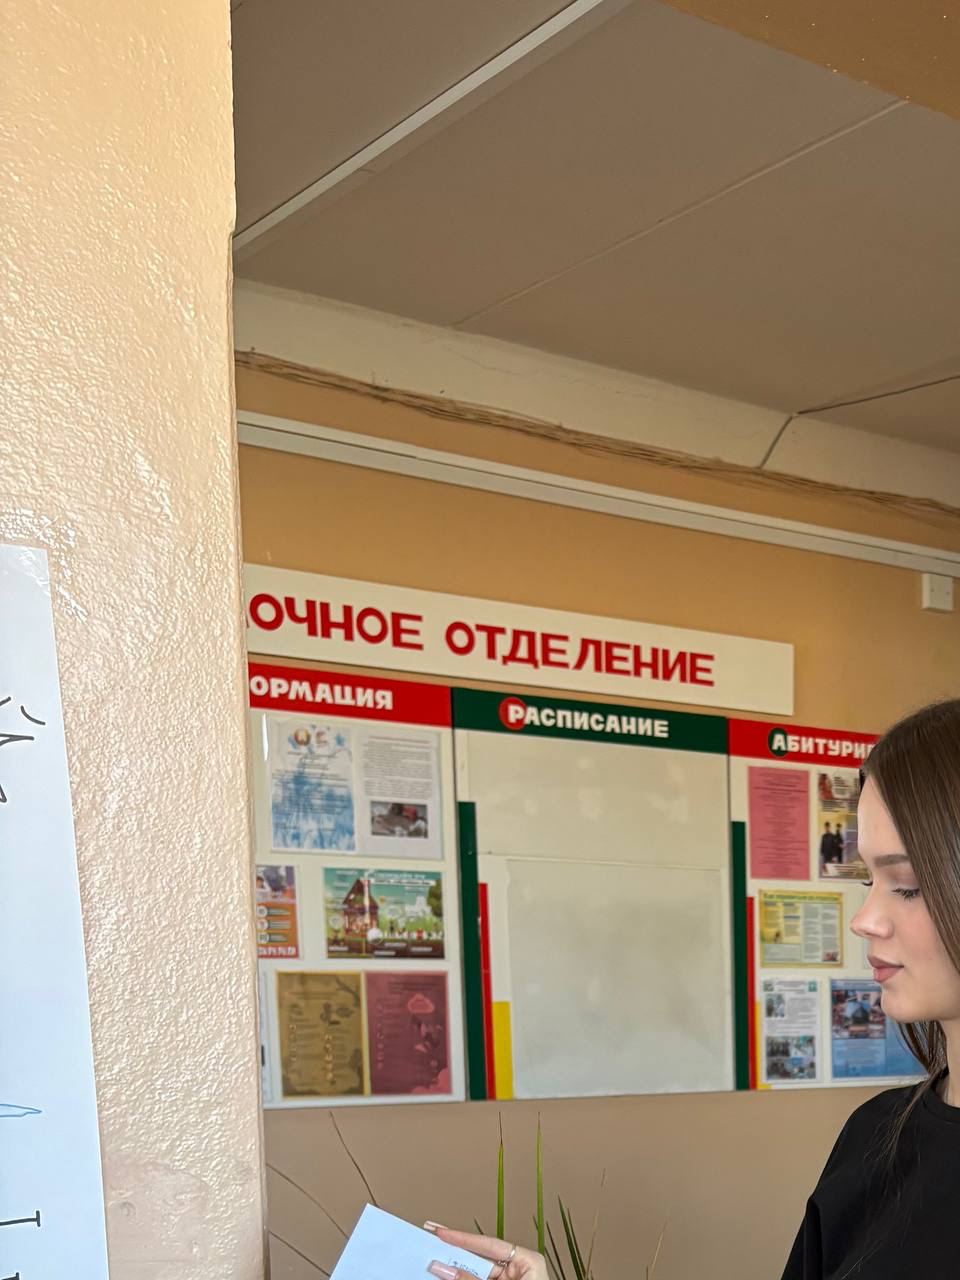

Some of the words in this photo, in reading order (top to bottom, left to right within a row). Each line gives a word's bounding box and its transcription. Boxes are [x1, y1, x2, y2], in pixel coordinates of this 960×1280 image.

[247, 593, 425, 651] ОЧНОЕ
[445, 621, 715, 687] ОТДЕЛЕНИЕ
[249, 675, 393, 711] ОРМАЦИЯ
[507, 703, 669, 738] РАСПИСАНИЕ
